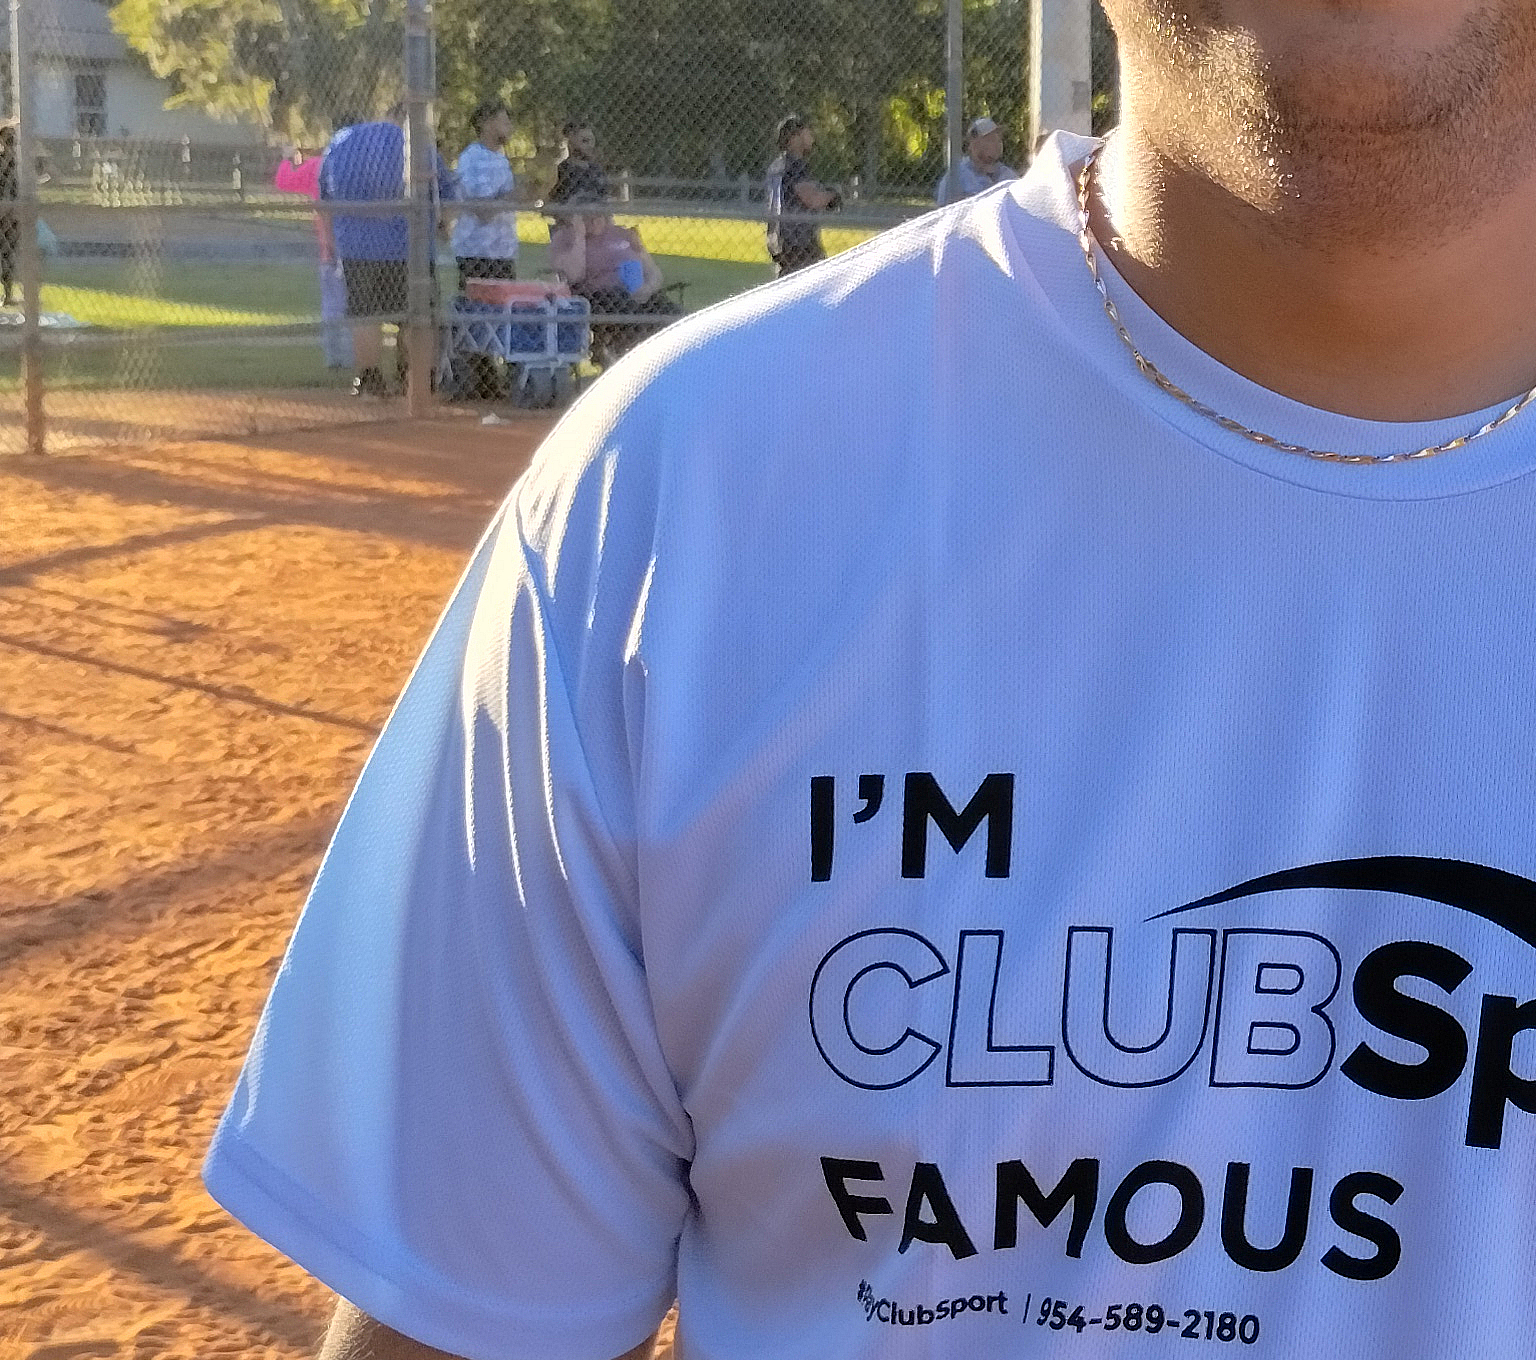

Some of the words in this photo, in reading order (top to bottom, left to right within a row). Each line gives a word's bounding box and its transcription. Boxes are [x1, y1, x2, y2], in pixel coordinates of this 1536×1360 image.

[811, 772, 1015, 882] I'M
[820, 1156, 1404, 1281] FAMOUS
[1037, 1297, 1260, 1344] 954-589-2180
